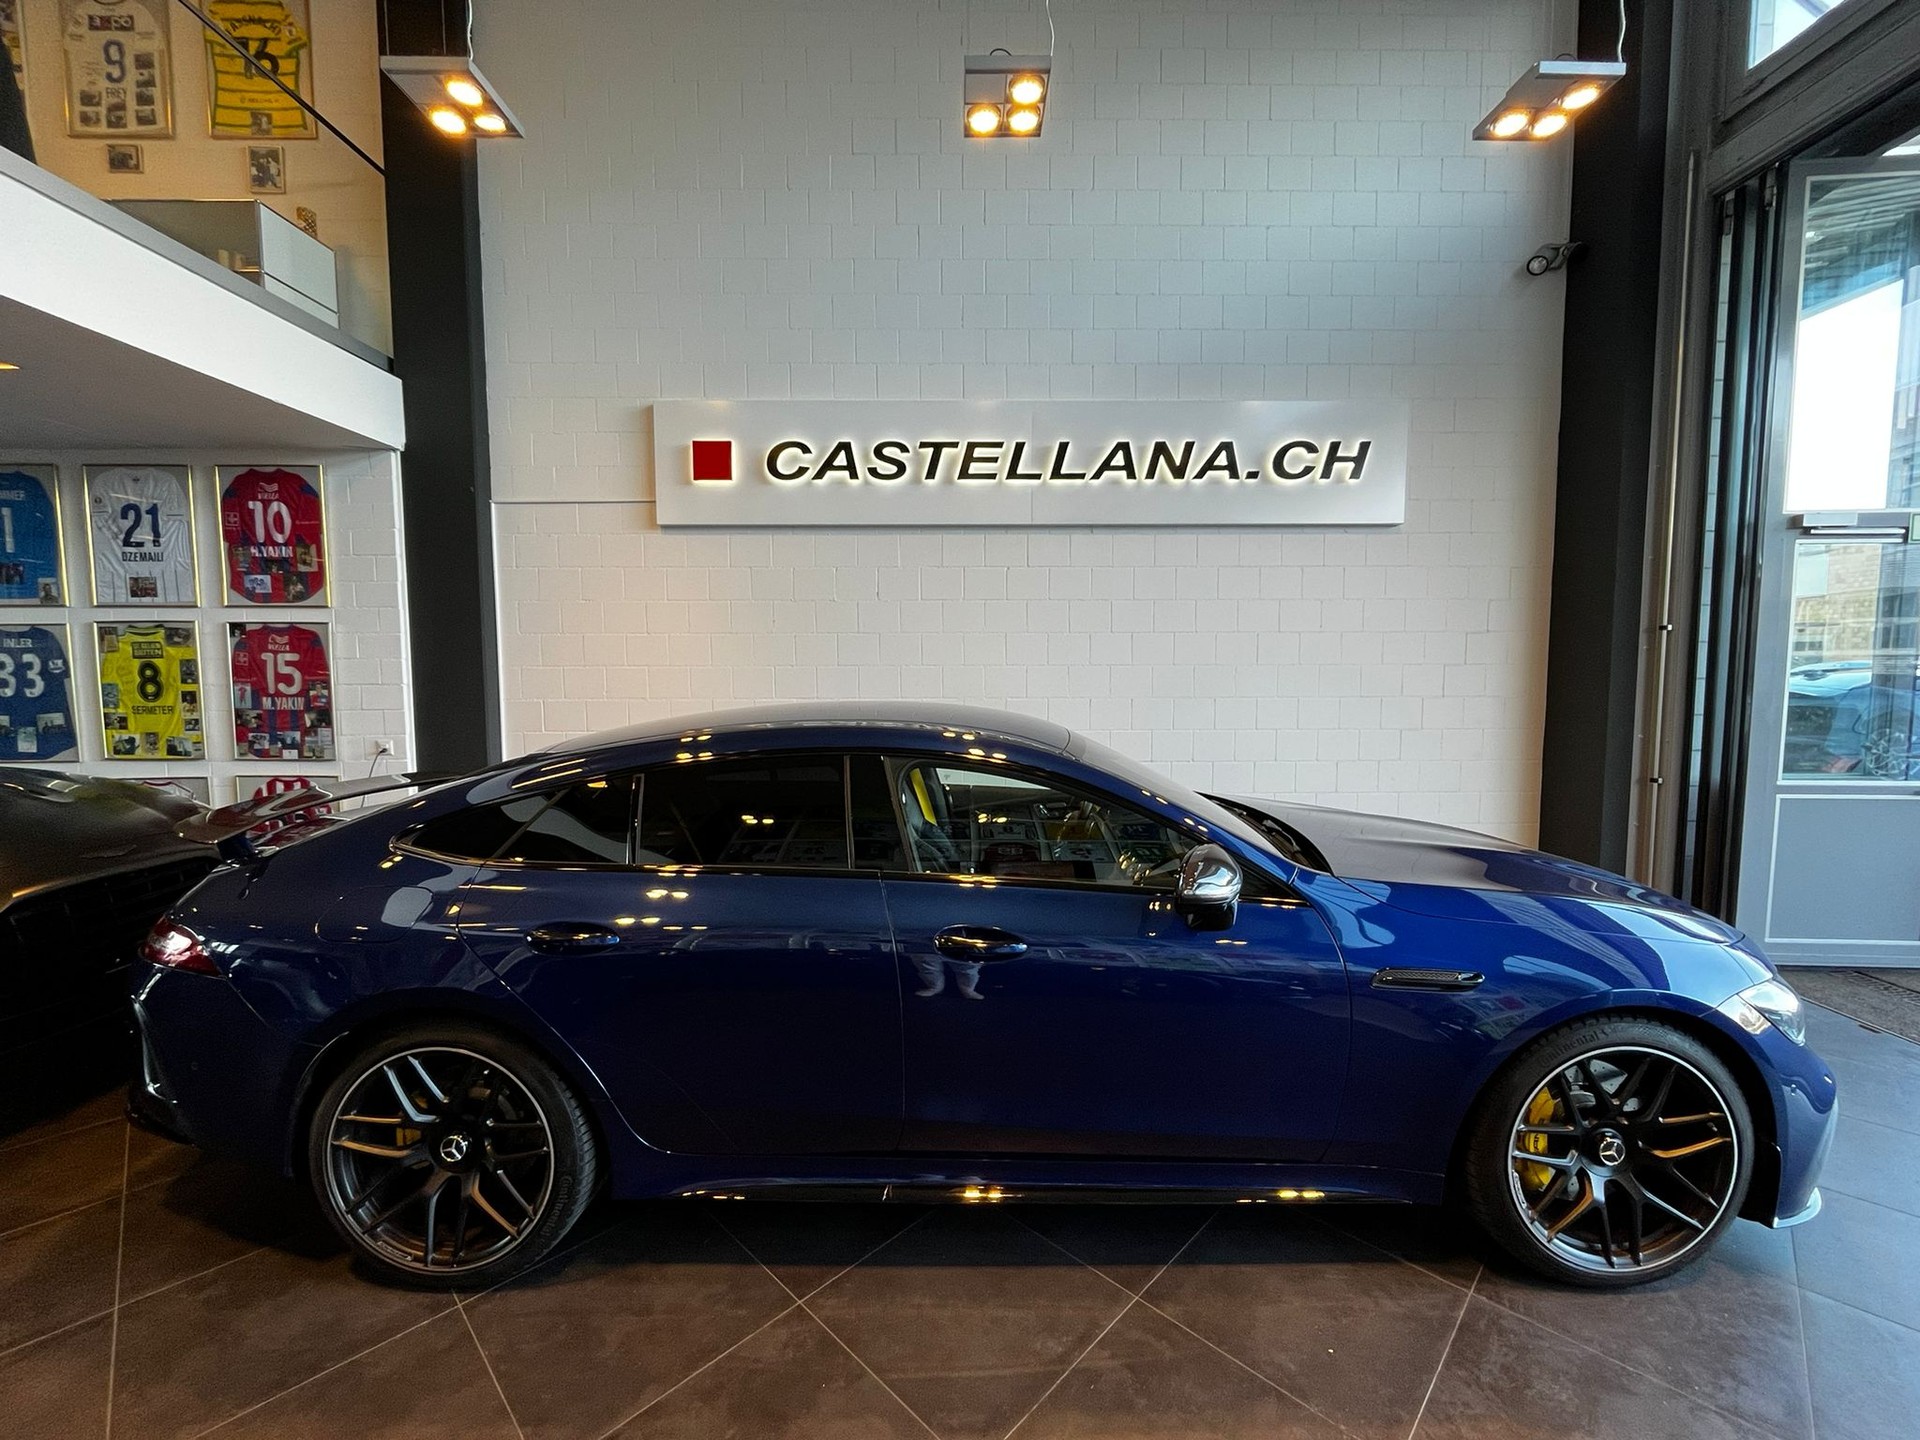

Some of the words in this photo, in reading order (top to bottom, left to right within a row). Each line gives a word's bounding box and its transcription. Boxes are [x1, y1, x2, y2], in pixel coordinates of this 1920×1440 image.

[103, 39, 126, 83] 9
[234, 38, 279, 79] 16
[105, 87, 127, 99] FREY
[765, 439, 1372, 481] CASTELLANA.CH
[120, 503, 161, 547] 21
[248, 501, 292, 544] 10
[122, 551, 164, 562] DZEMAILI
[3, 638, 33, 648] INLER
[137, 661, 164, 702] 8
[261, 653, 302, 695] 15
[132, 705, 174, 714] SERMETER
